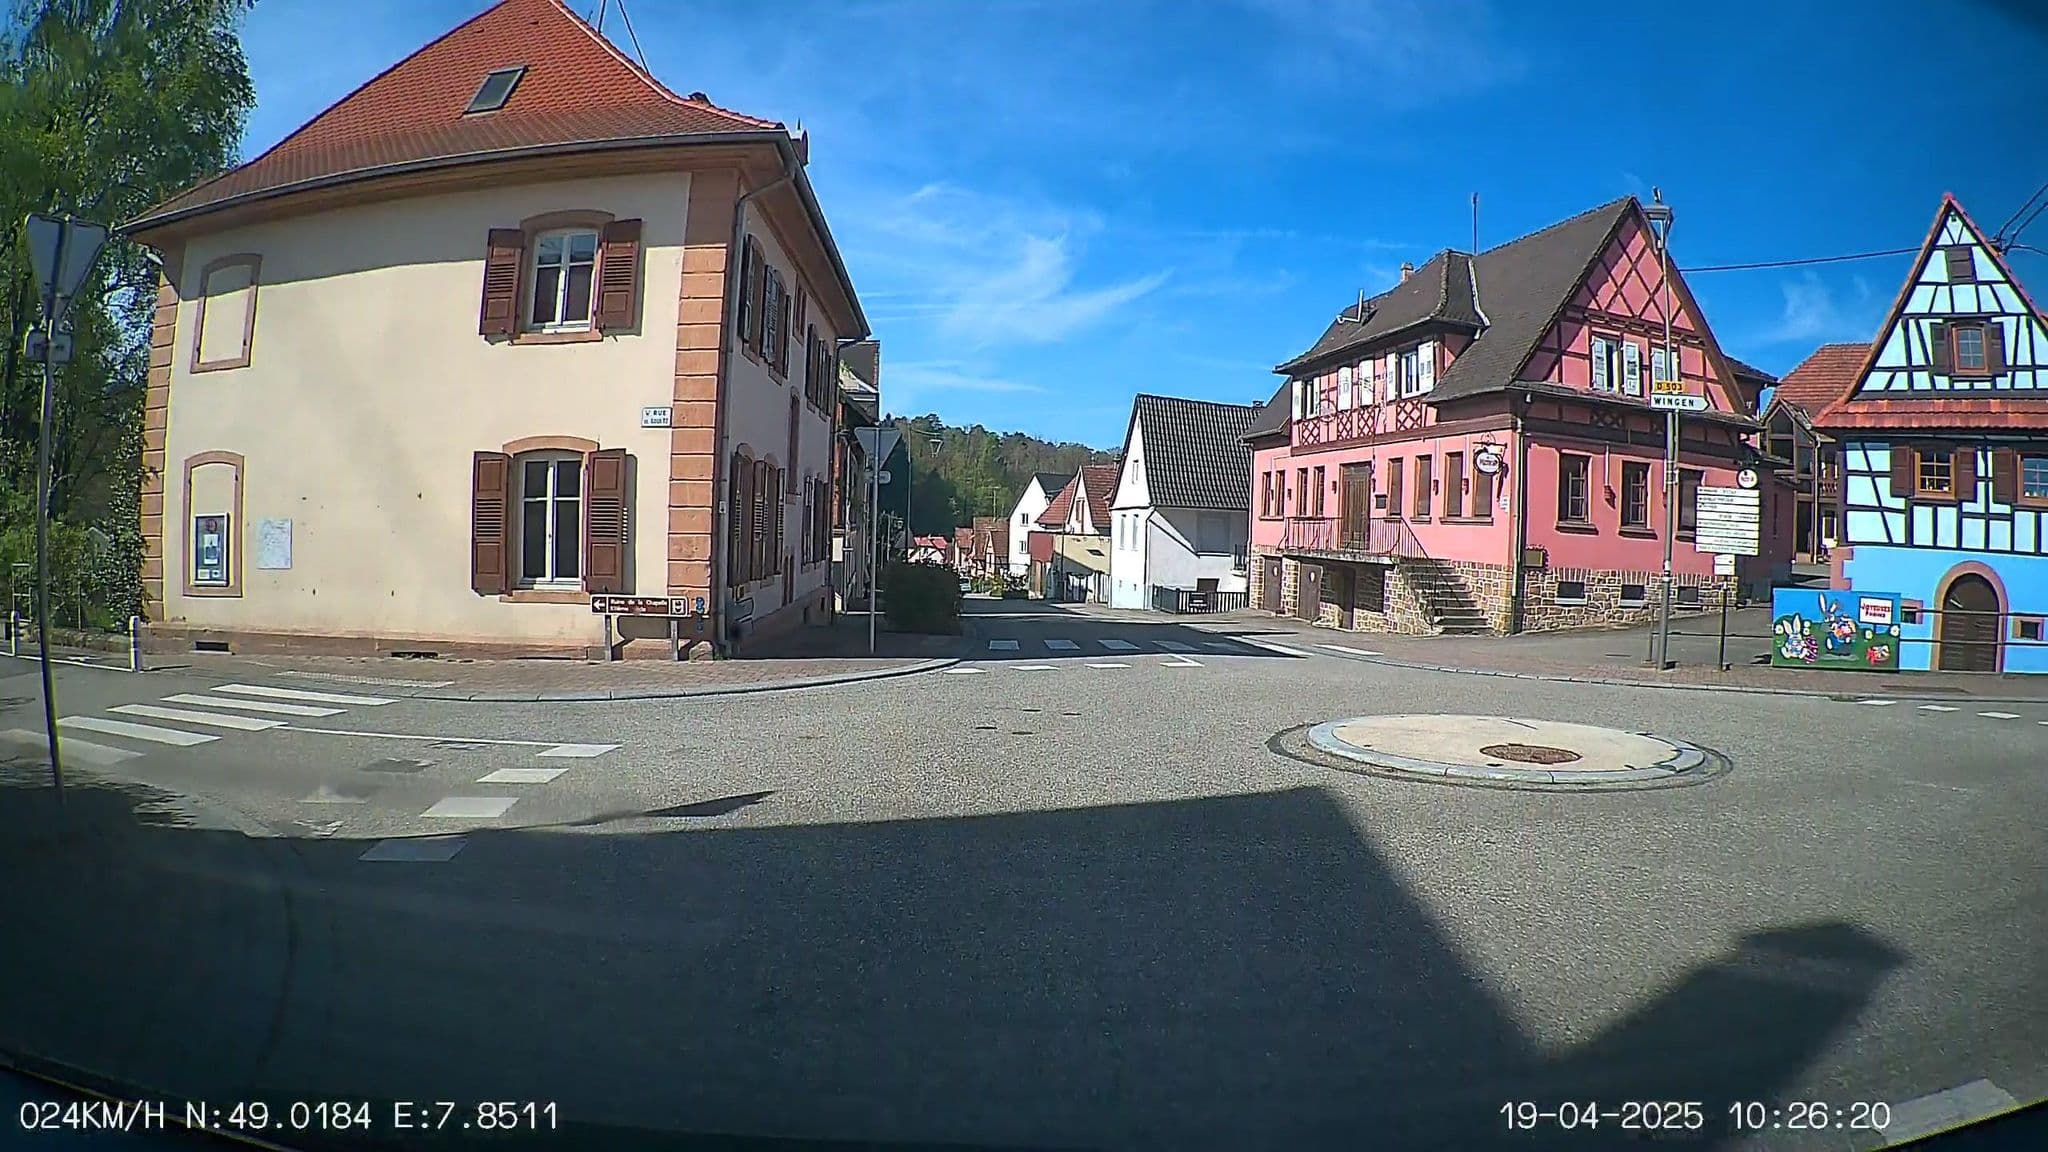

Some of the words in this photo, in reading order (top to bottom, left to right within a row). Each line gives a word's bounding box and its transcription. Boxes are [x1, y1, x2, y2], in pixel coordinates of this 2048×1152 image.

[1657, 382, 1663, 391] D
[1665, 382, 1683, 391] 503
[1653, 396, 1694, 407] WINGEN
